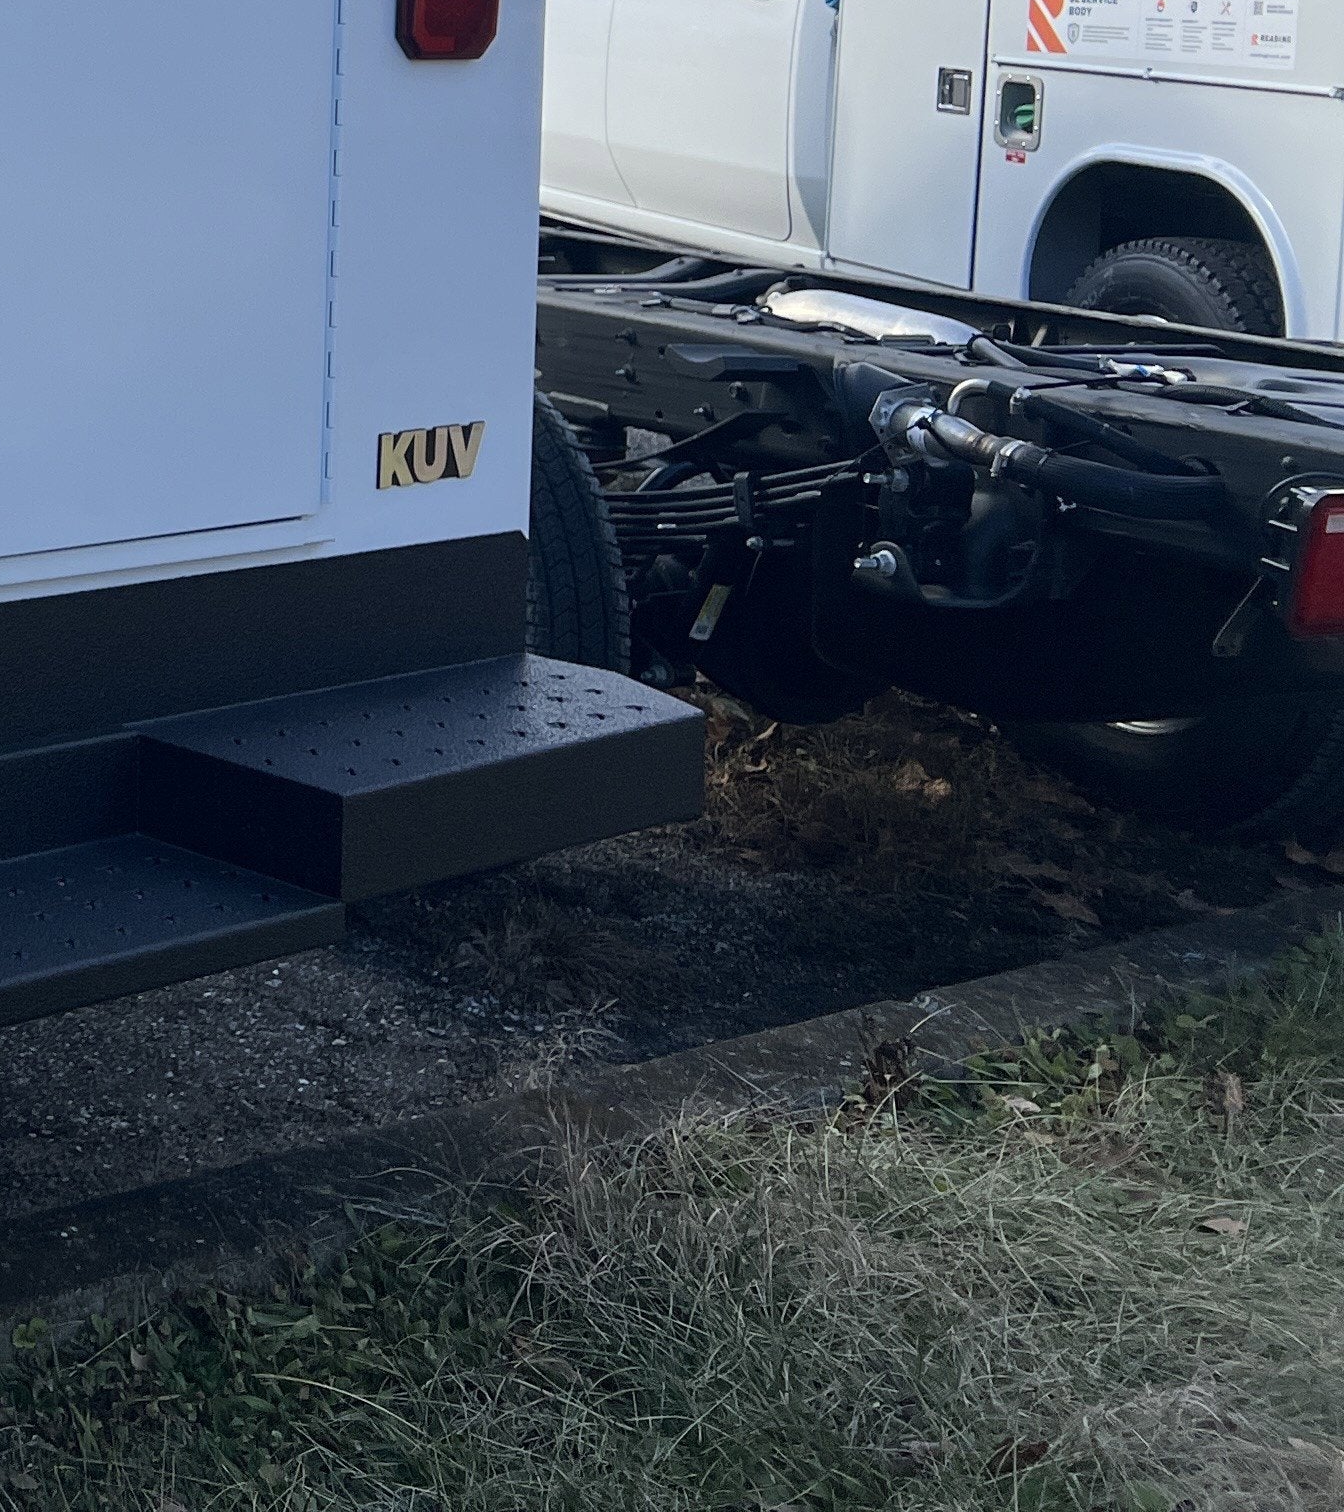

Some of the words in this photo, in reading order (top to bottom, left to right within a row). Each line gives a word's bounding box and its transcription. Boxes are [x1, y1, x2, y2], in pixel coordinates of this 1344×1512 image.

[1069, 6, 1092, 16] BODY
[1261, 34, 1292, 44] READING
[376, 420, 486, 489] KUV
